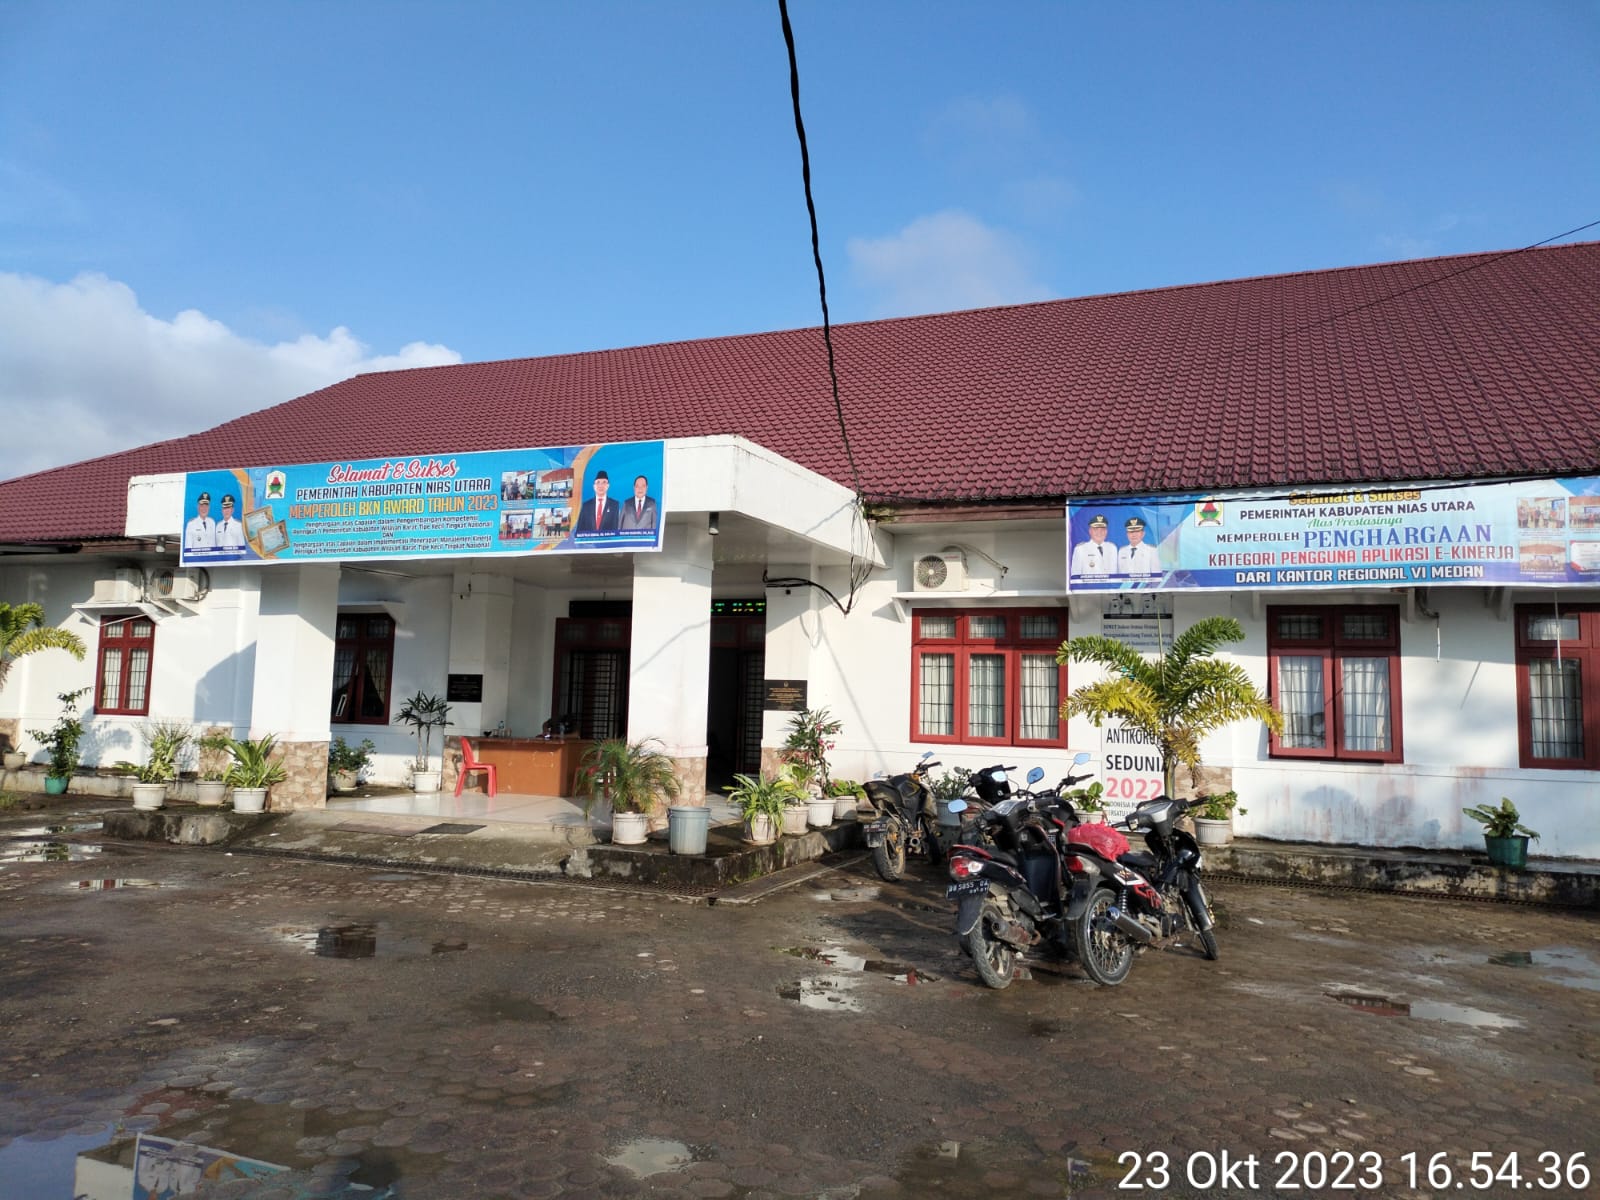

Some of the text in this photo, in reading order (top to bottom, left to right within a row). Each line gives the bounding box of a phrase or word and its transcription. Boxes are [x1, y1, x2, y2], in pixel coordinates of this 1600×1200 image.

[327, 459, 457, 483] Selamat & Sukses
[297, 478, 491, 501] PEMERINTAH KABUPATEN NIAS UTARA
[289, 501, 356, 519] MEMPEROLEH
[359, 500, 381, 516] BKN
[383, 498, 425, 515] AWARD
[427, 496, 465, 513] TAHUN
[467, 494, 498, 512] 2023
[1239, 500, 1476, 520] PEMERINTAH KABUPATEN NIAS UTARA
[1216, 524, 1492, 548] MEMPEROLEH PENGHARGAAN
[1208, 545, 1514, 567] KATEGORI PENGGUNA APLIKASI E-KINERJA
[1235, 565, 1485, 584] DARI KANTOR REGIONAL VI MEDAN
[1105, 776, 1164, 800] 2022
